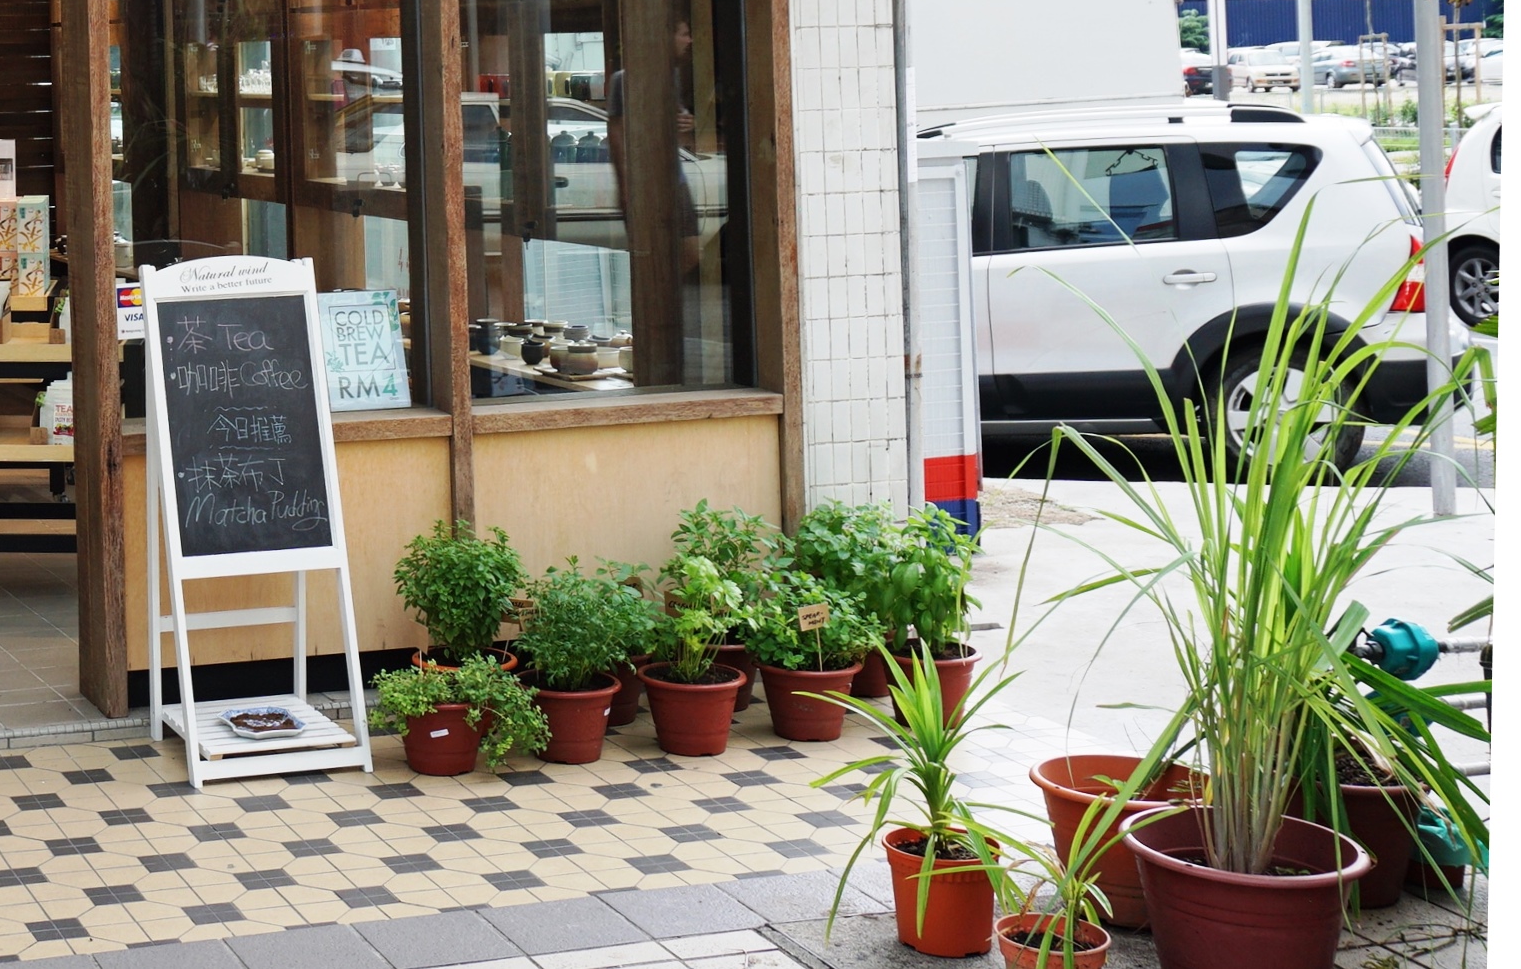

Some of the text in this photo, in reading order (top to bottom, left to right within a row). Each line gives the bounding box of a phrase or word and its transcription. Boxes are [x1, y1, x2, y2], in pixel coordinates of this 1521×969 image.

[179, 261, 269, 284] Natural wind
[181, 283, 207, 293] Write
[217, 280, 243, 290] better
[245, 276, 273, 286] future
[124, 312, 144, 322] VISA
[334, 309, 384, 327] COLD
[176, 315, 275, 354] 茶 Tea
[336, 324, 385, 342] BREW
[338, 341, 391, 366] TEA
[176, 358, 309, 399] 咖啡 Coffee
[55, 404, 74, 413] TEA
[185, 452, 286, 492] 抹茶布丁
[185, 488, 328, 532] Matcha Pudding
